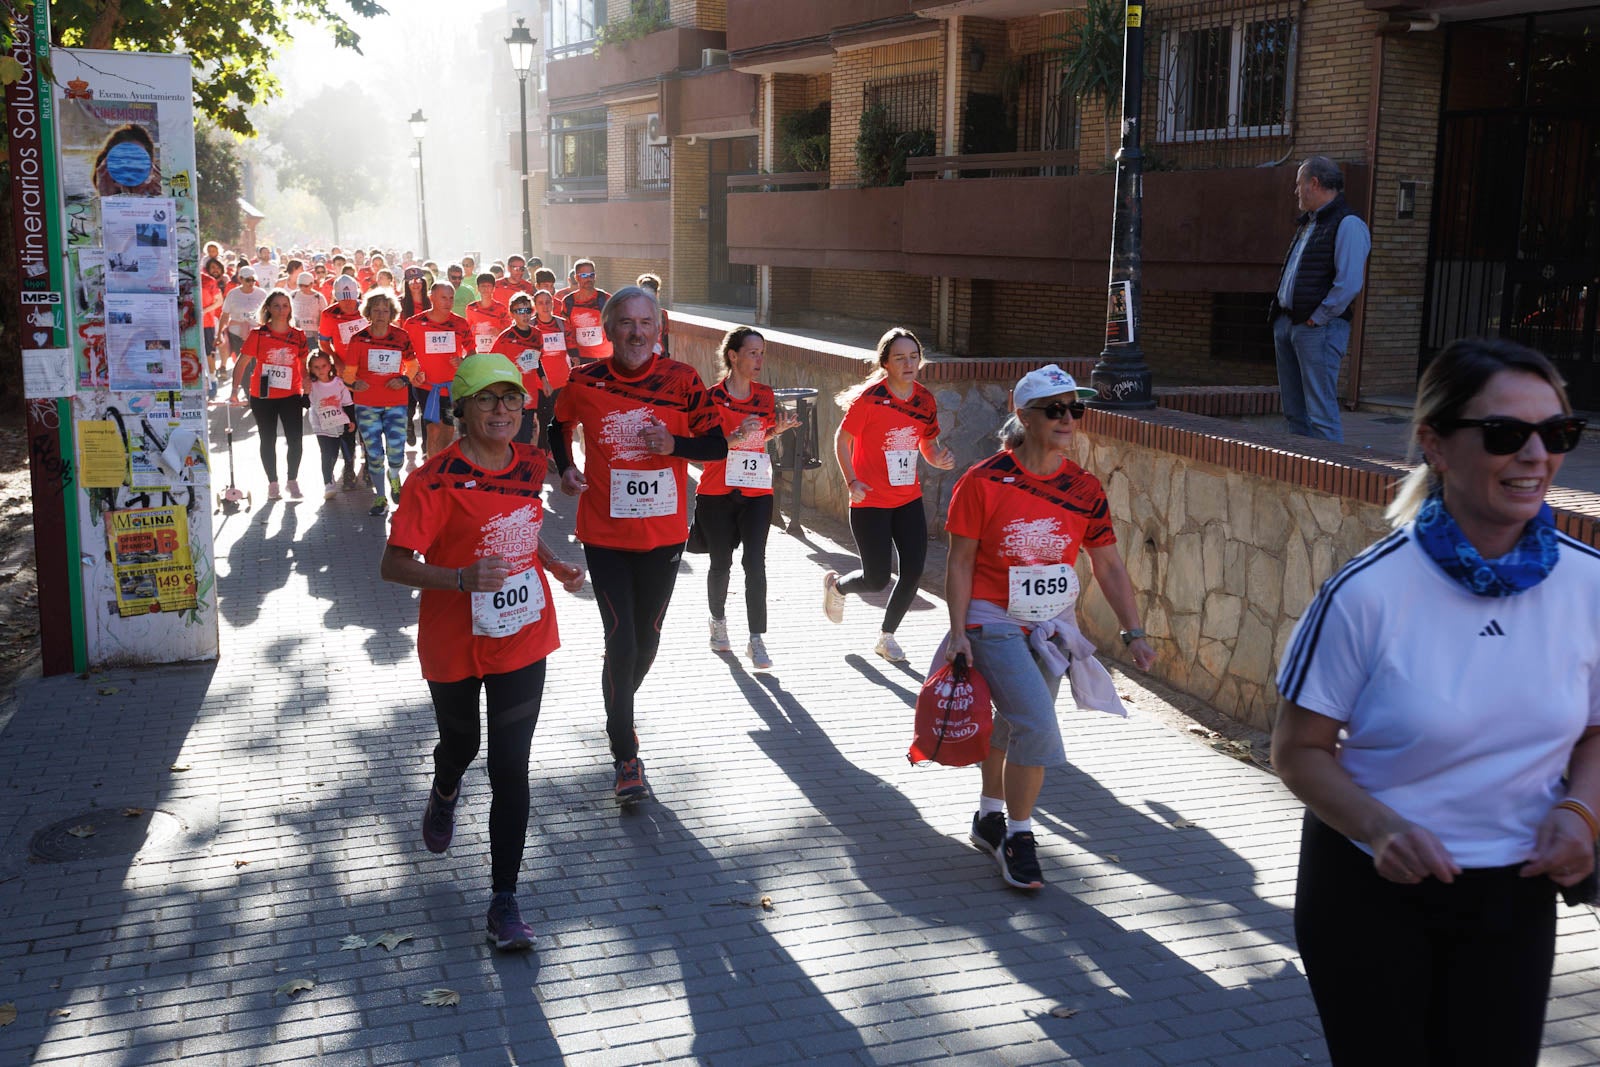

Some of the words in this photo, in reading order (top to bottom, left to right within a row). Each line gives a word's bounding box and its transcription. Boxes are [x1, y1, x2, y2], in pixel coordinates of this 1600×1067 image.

[39, 45, 47, 56] de
[11, 7, 36, 140] Saludable
[131, 91, 185, 102] Ayuntamiento
[41, 98, 50, 119] Ruta
[23, 293, 60, 303] MPS
[348, 325, 359, 333] 96
[742, 459, 757, 471] 13
[898, 457, 908, 469] 14
[626, 480, 658, 495] 601
[117, 514, 174, 529] MOLINA
[484, 526, 538, 545] carrer
[1005, 534, 1067, 550] carrera
[158, 575, 180, 588] 149
[184, 573, 194, 585] €
[1021, 576, 1068, 596] 1659
[493, 585, 529, 610] 600
